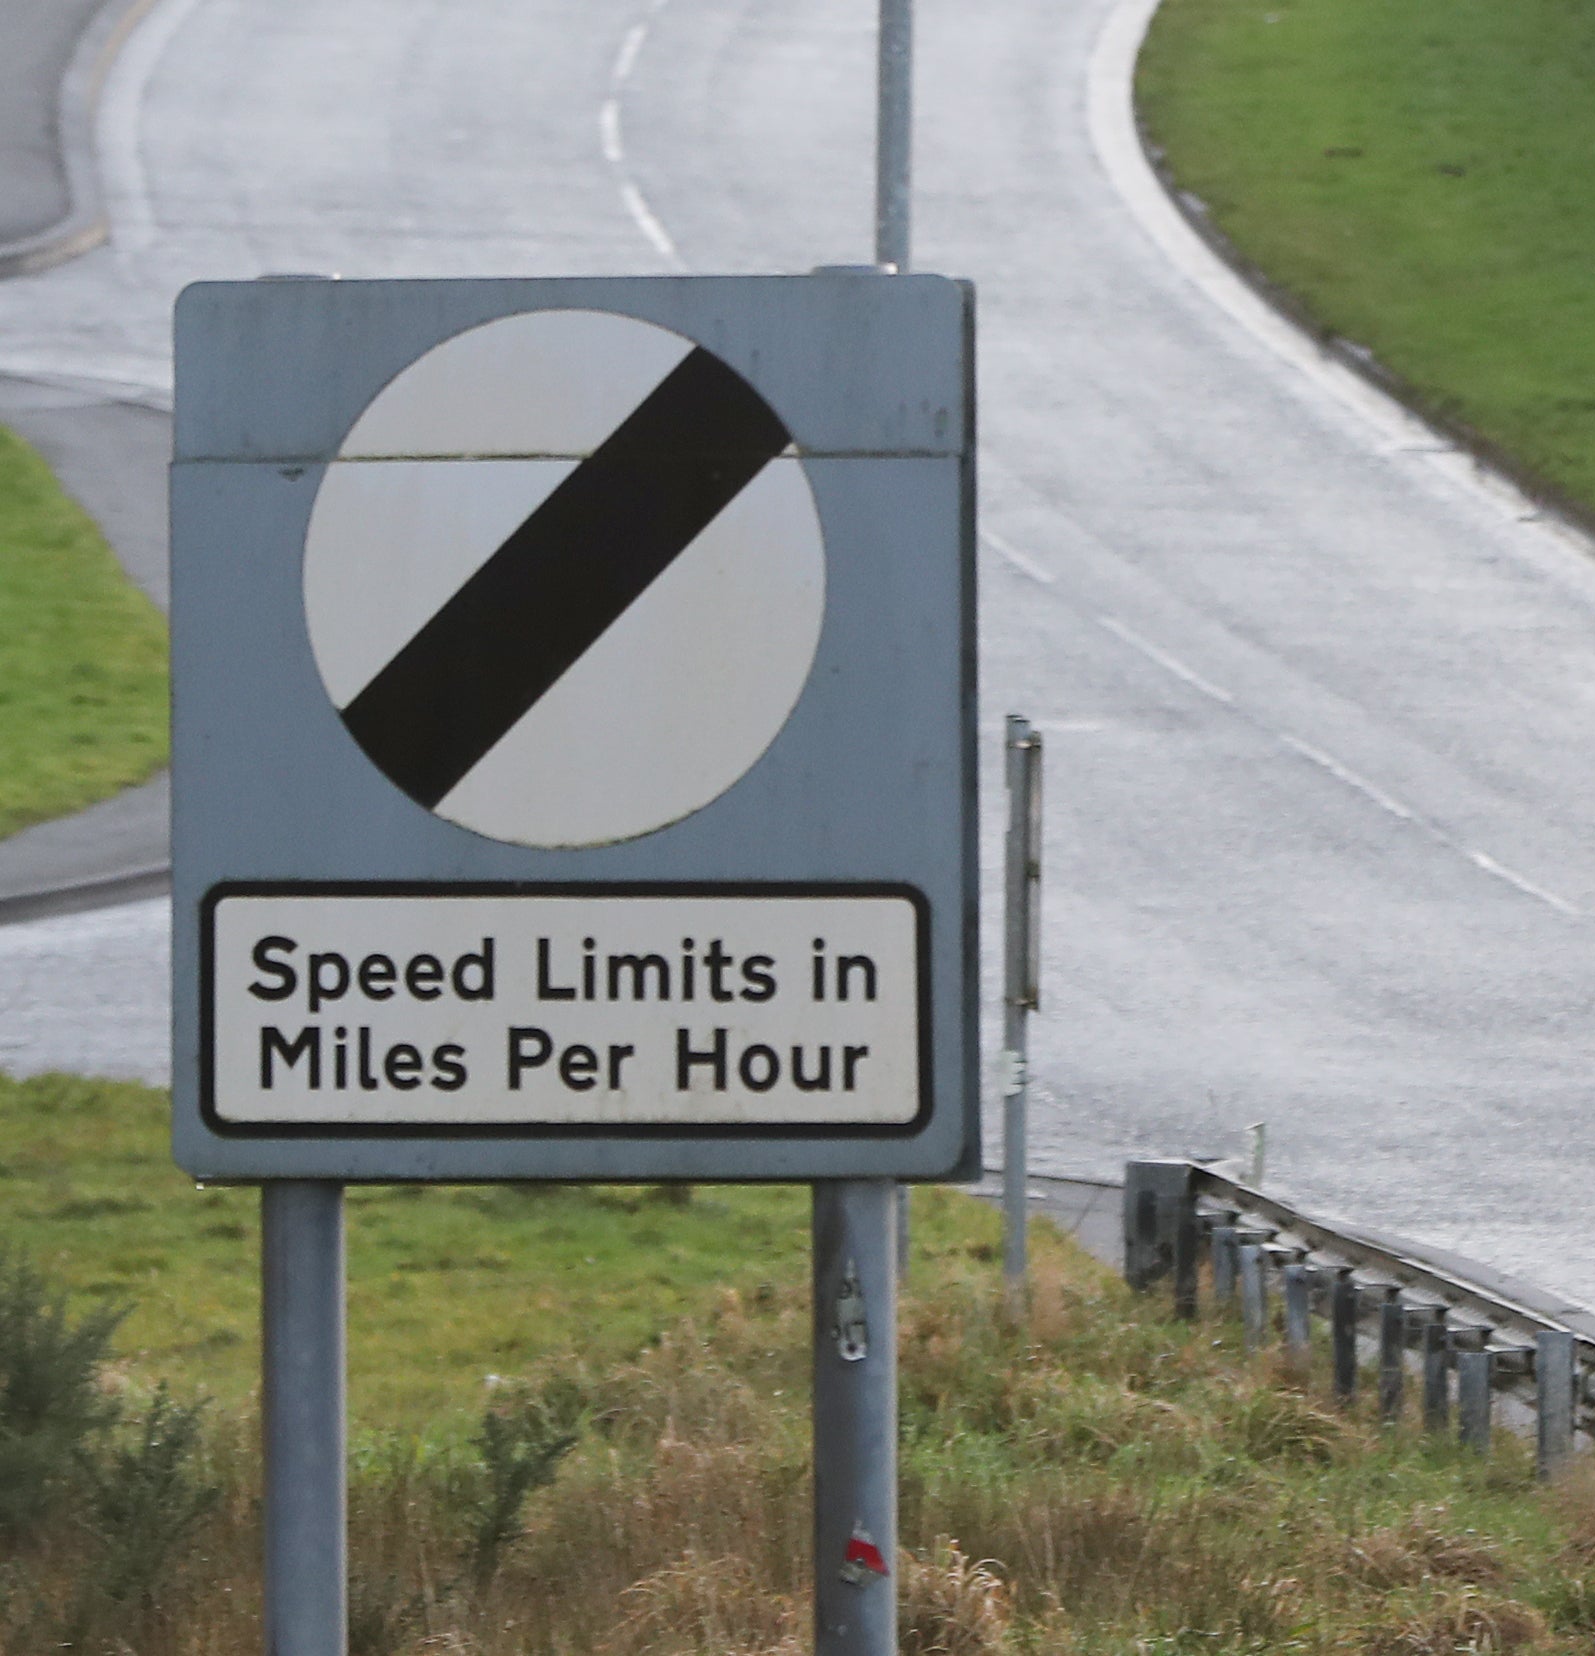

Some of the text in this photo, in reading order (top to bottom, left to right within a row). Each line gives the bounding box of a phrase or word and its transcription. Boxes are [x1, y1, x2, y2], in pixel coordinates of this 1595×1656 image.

[247, 935, 877, 1012] Speed Limits in
[259, 1026, 869, 1093] Miles Per Hour
